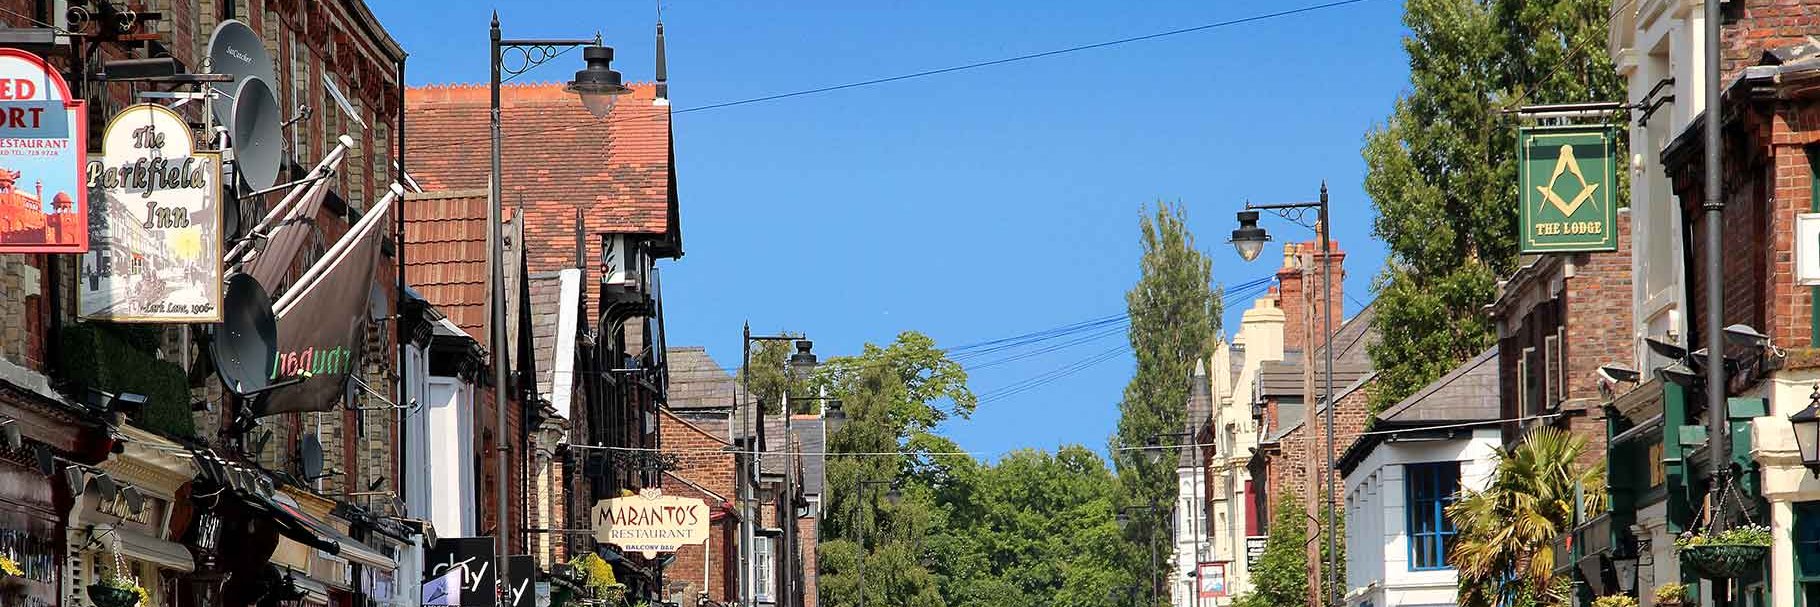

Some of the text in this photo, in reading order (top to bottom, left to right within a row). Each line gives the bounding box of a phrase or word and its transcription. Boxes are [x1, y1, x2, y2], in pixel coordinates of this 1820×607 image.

[132, 124, 166, 150] The
[86, 156, 211, 199] Parkfield
[143, 200, 191, 230] Inn
[1536, 222, 1602, 235] THE LODGE
[598, 504, 698, 526] MARANTO'S
[611, 528, 693, 539] RESTAURANT
